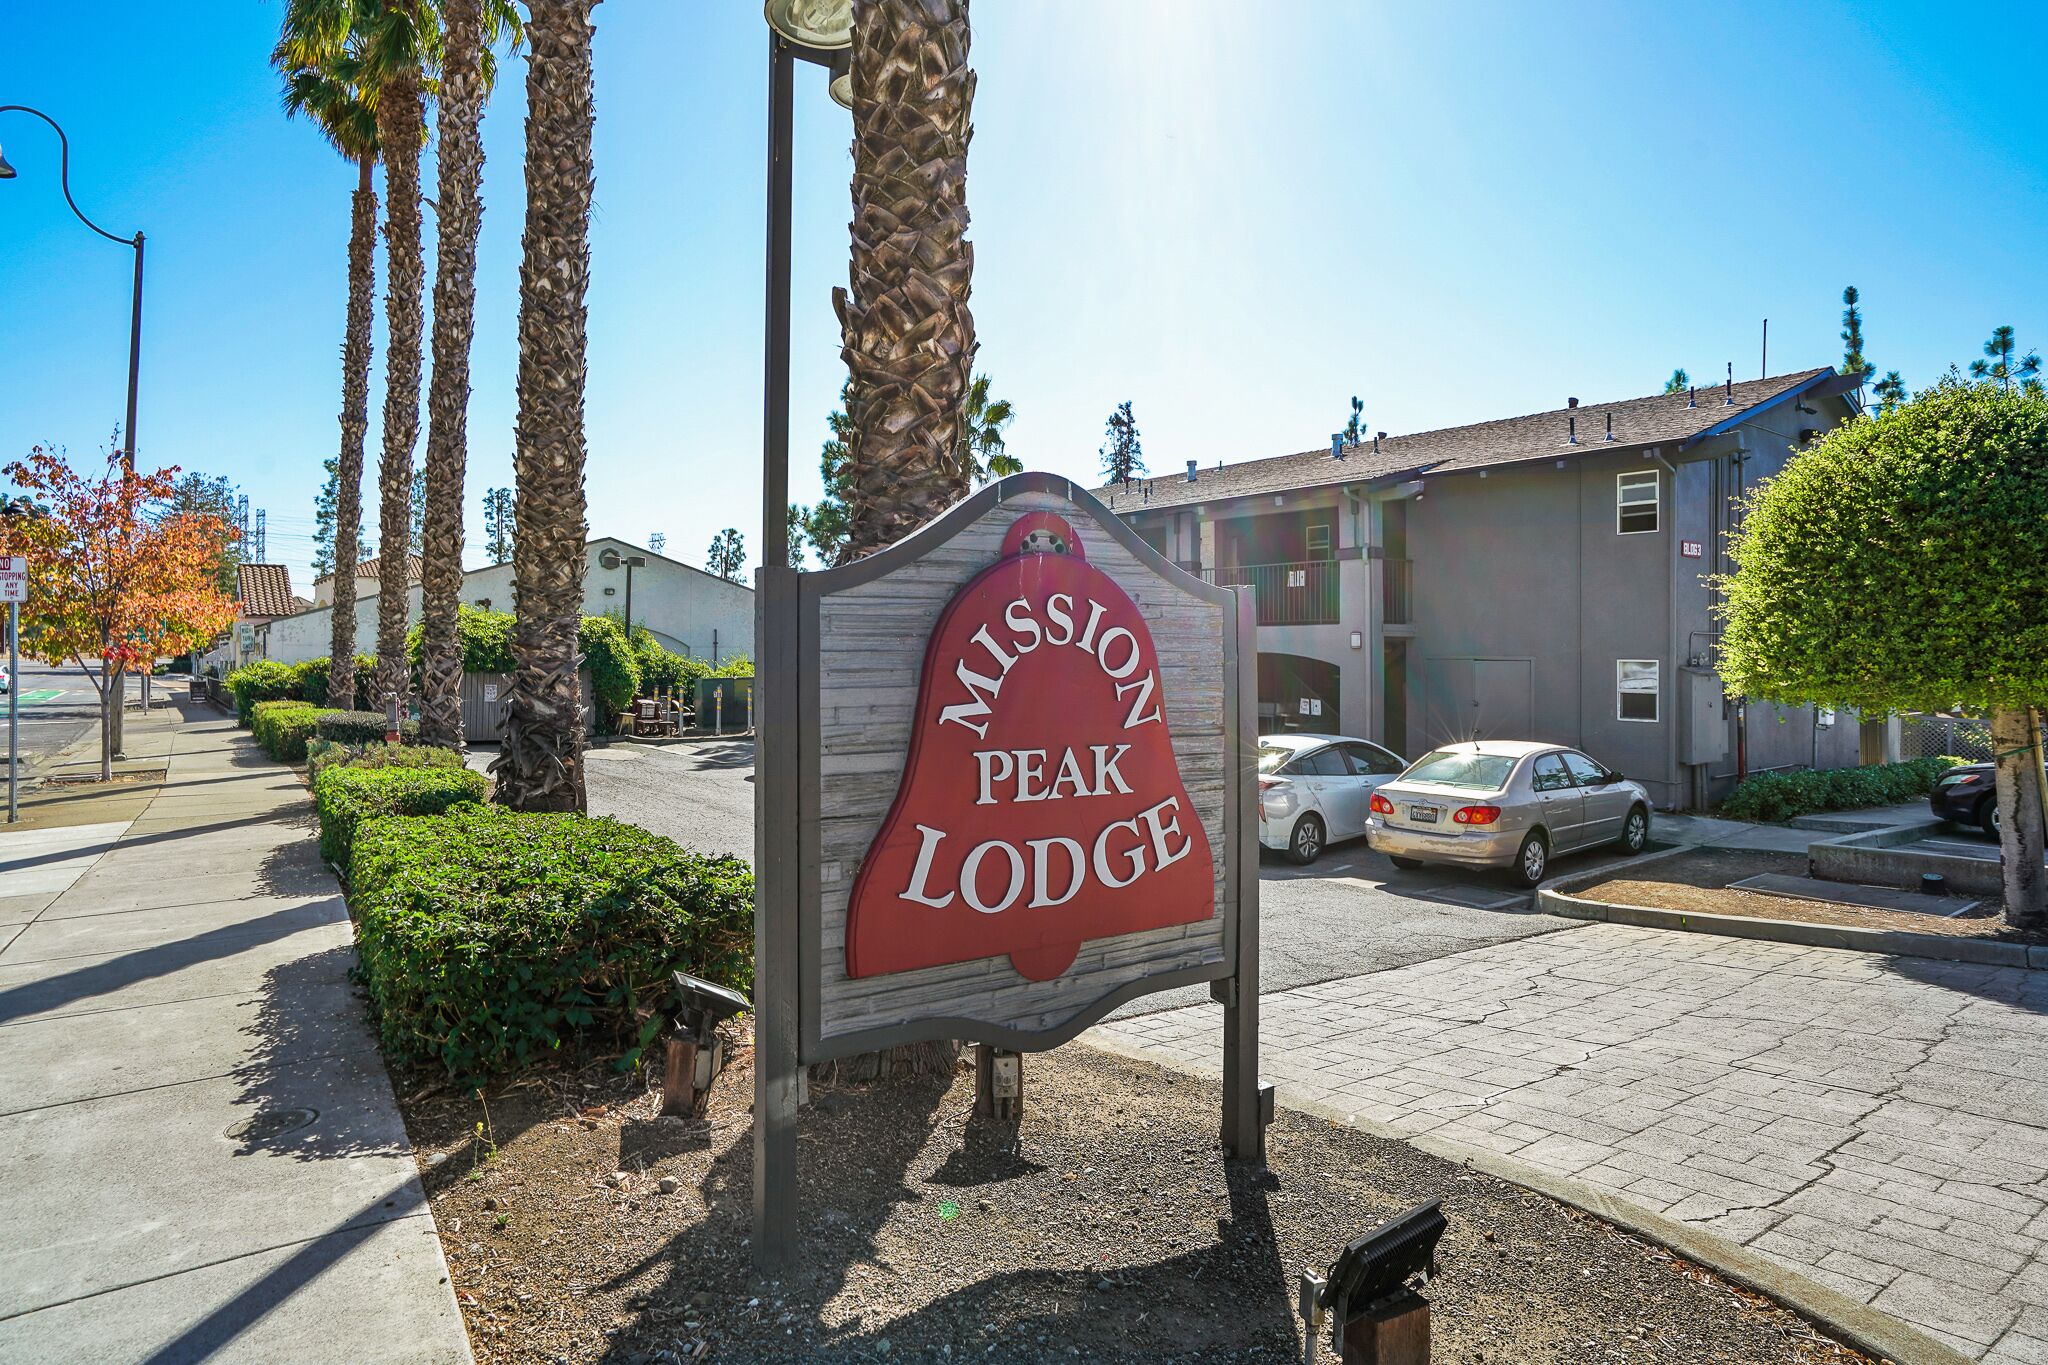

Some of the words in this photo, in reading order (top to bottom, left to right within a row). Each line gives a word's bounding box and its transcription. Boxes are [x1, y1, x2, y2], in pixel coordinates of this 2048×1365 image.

[0, 571, 26, 581] TOPPING
[4, 589, 20, 597] TIME
[938, 593, 1162, 740] MISSION
[972, 744, 1134, 805] PEAK
[898, 796, 1192, 914] LODGE
